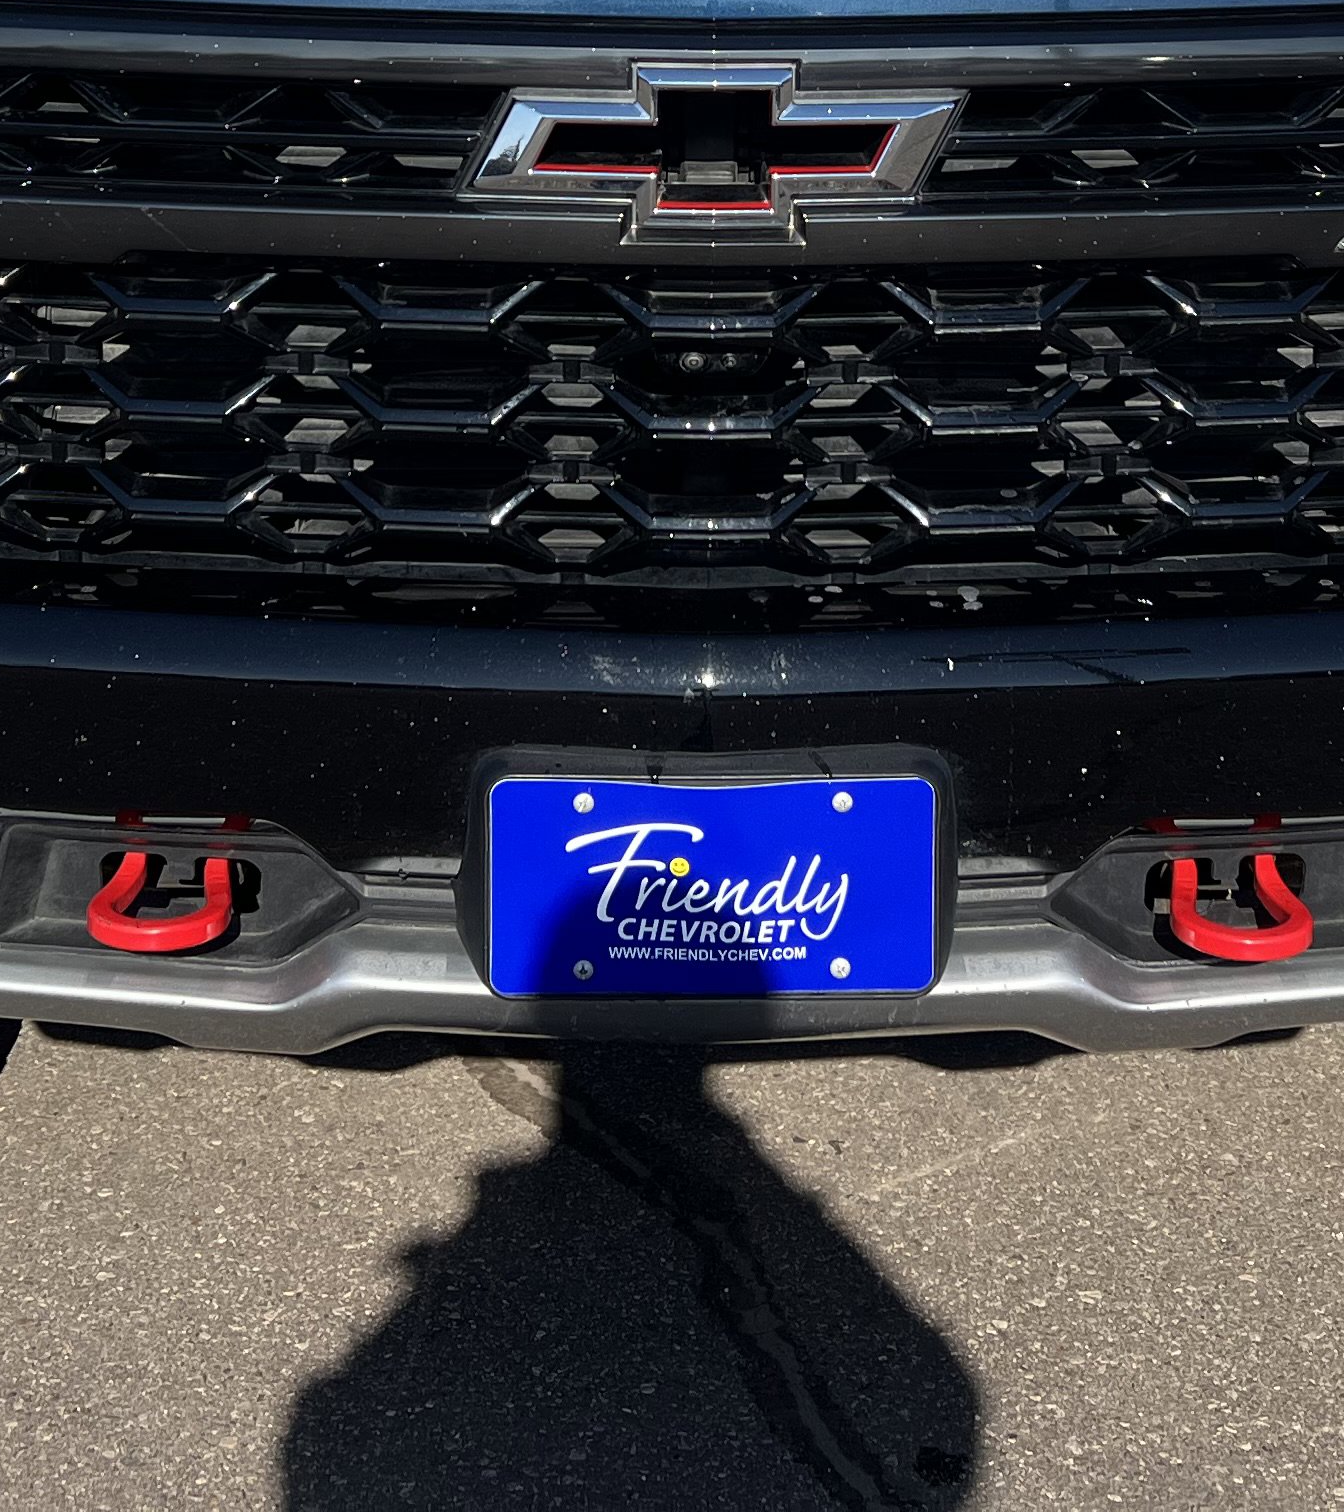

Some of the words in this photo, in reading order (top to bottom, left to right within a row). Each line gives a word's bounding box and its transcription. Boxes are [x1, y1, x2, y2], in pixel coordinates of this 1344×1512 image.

[565, 821, 849, 941] Friendly
[617, 917, 795, 944] CHEVROLET
[608, 945, 807, 962] WWW.FRIENDLYCHEV.COM
